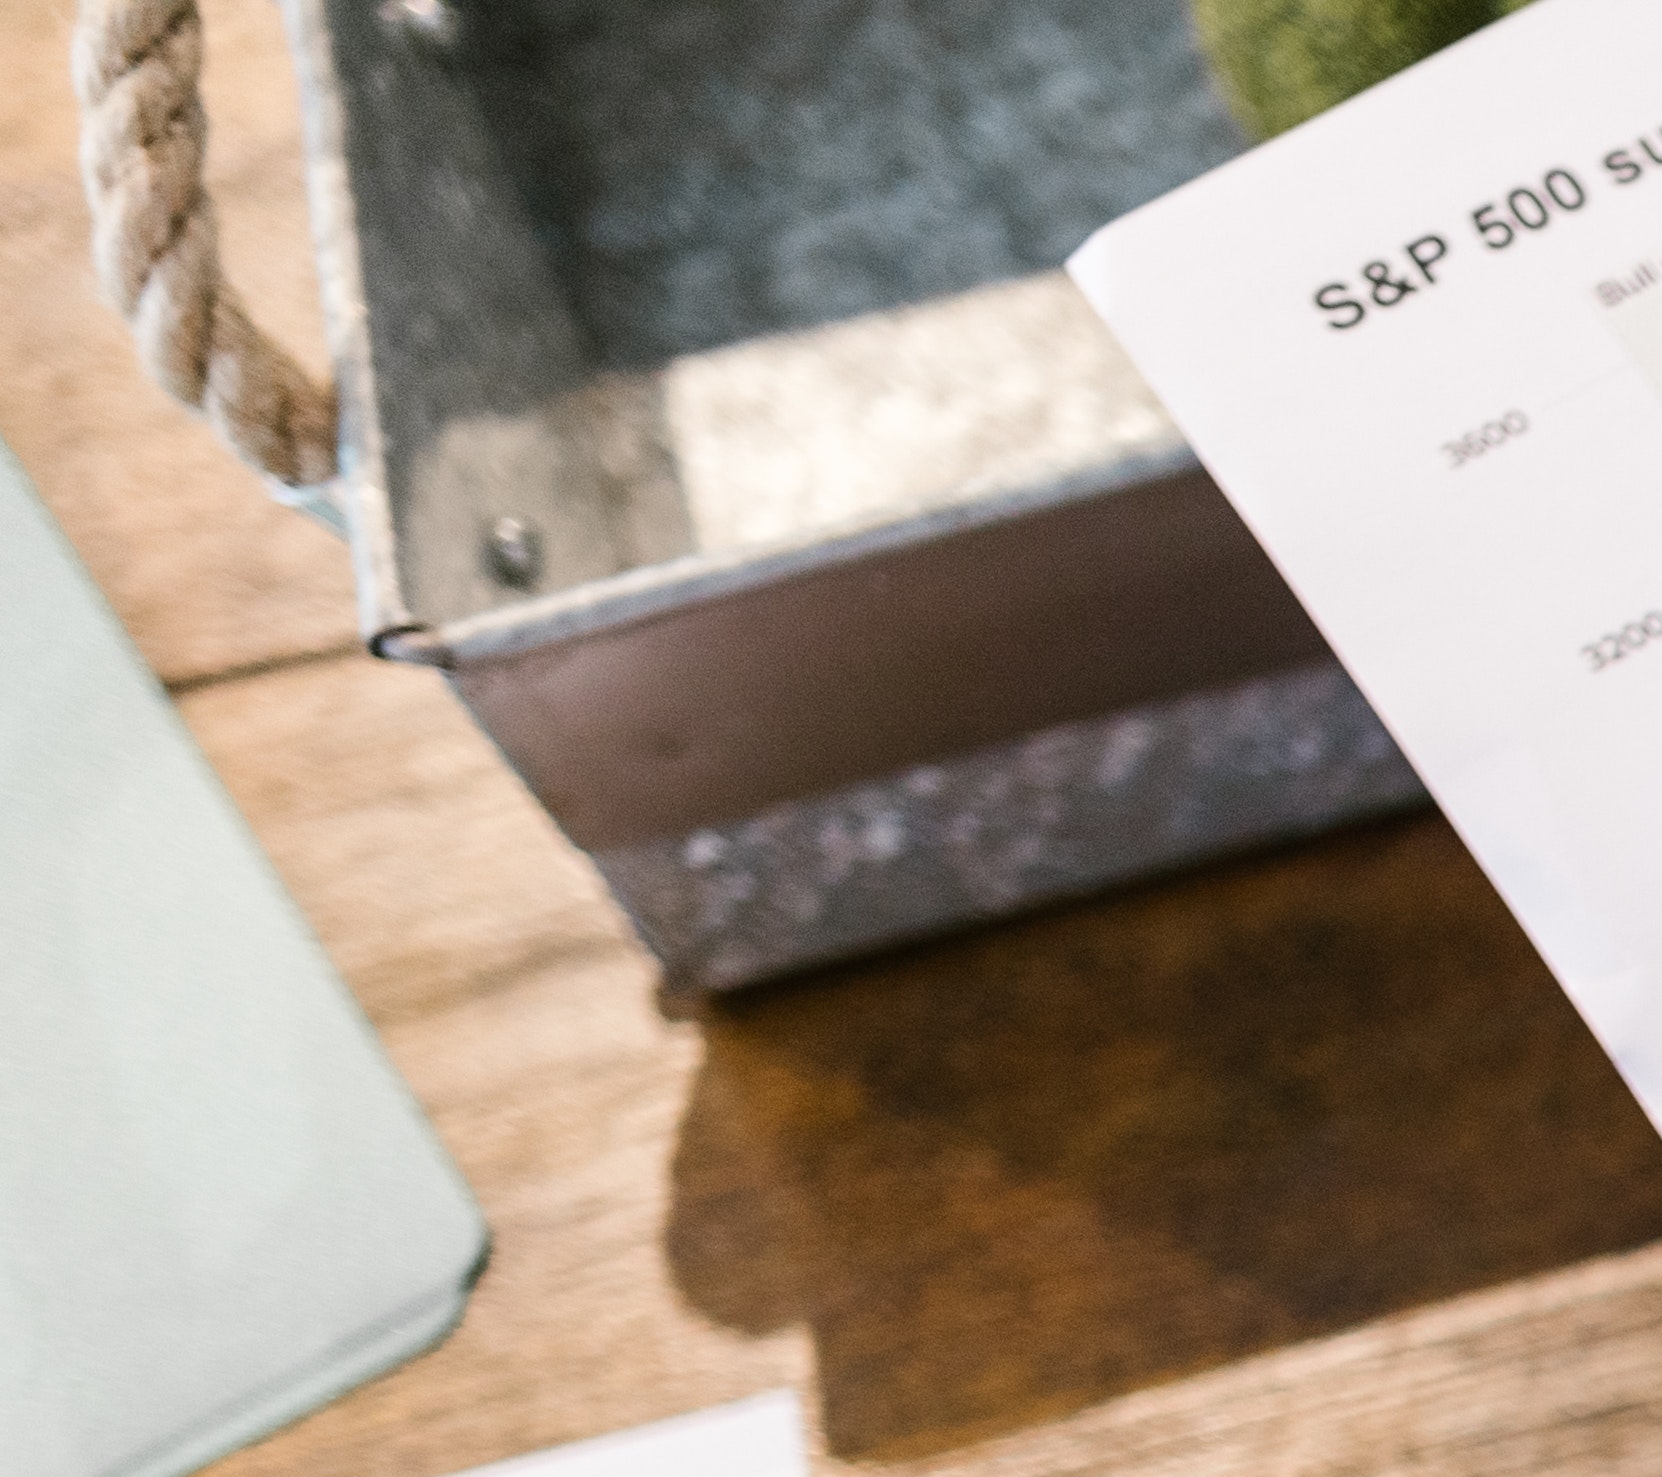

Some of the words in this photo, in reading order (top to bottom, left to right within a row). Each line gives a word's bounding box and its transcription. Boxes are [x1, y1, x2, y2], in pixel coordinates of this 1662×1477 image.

[1314, 234, 1448, 330] S&P
[1471, 168, 1587, 251] 500
[1442, 411, 1529, 467] 3600
